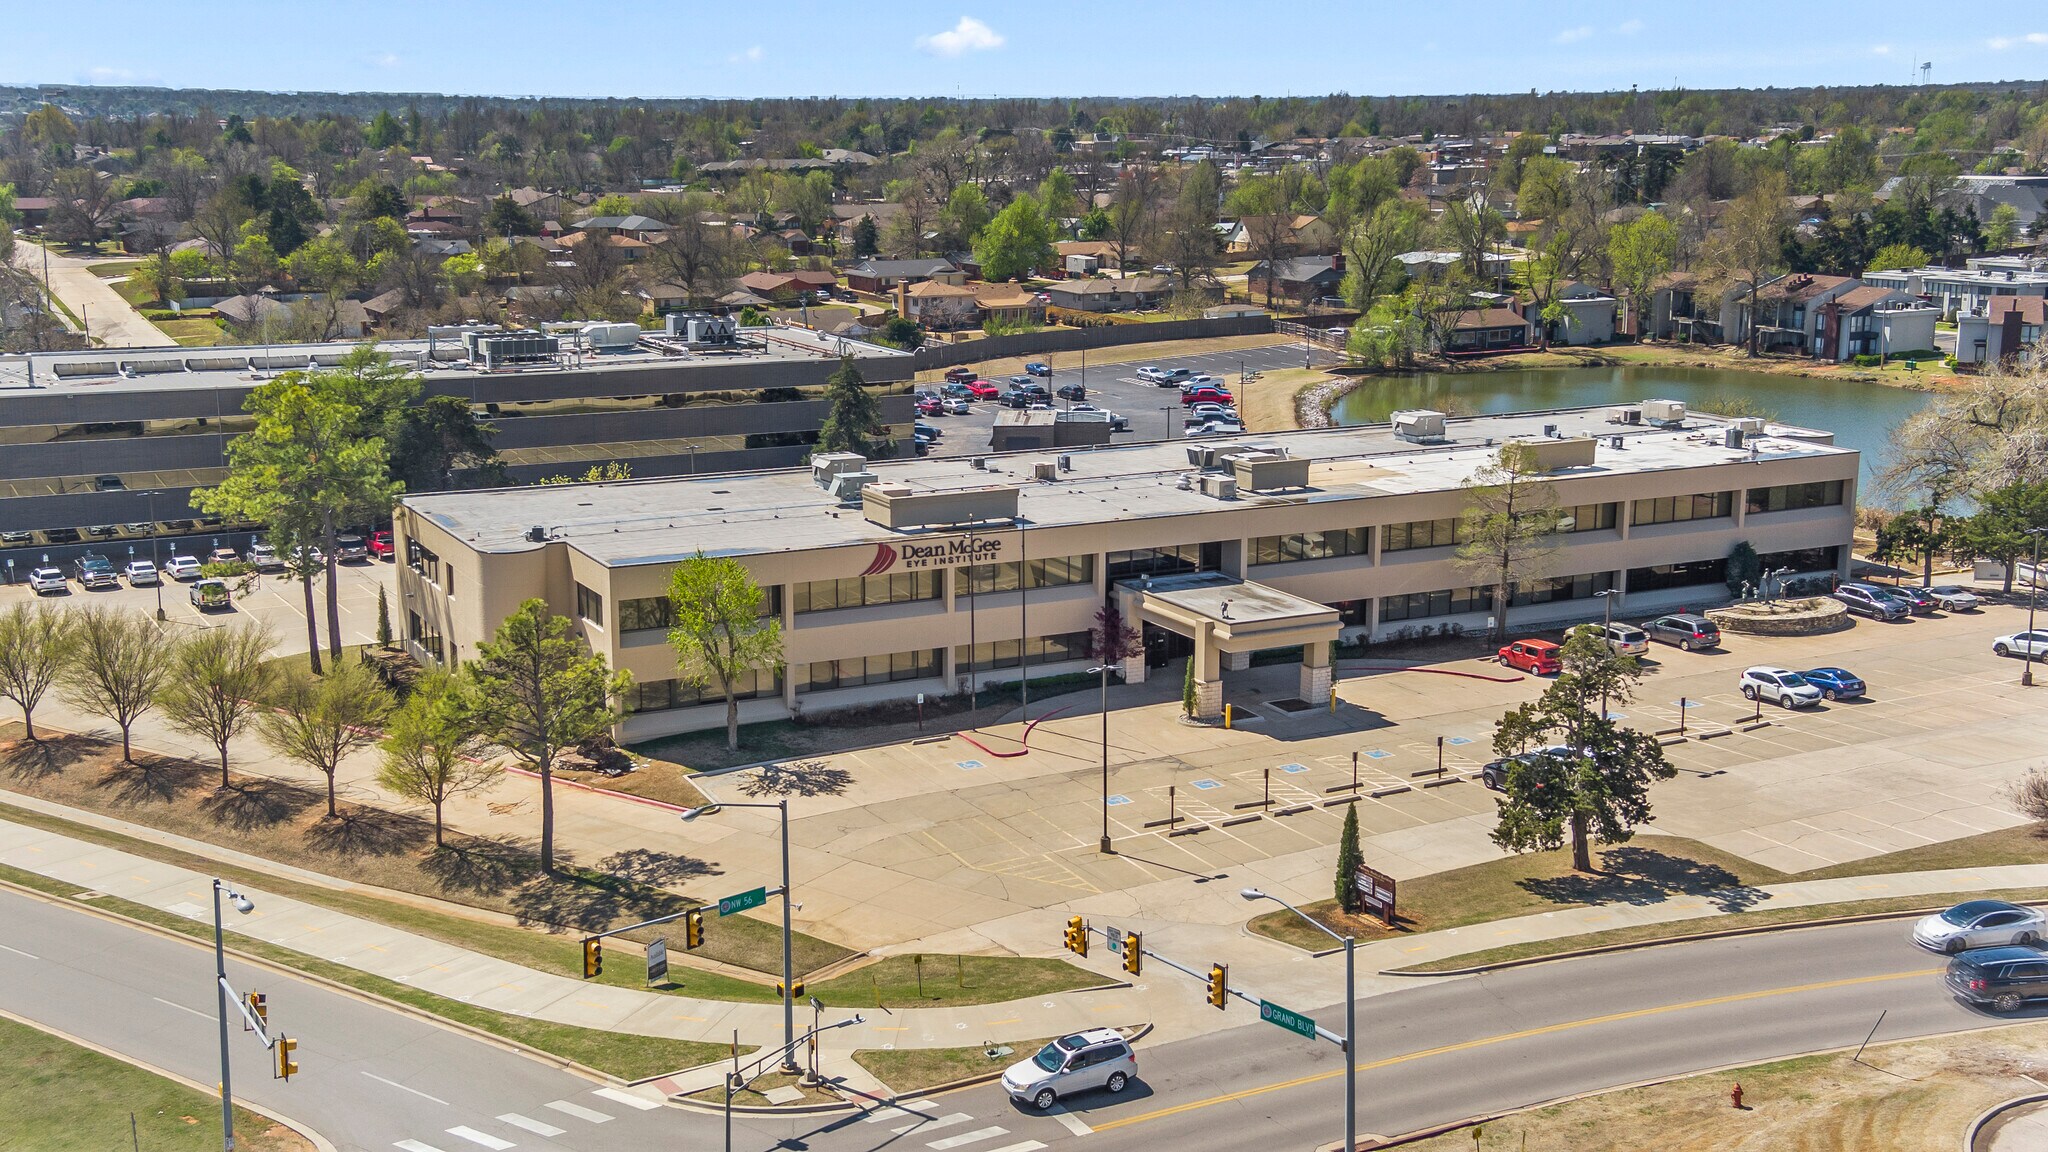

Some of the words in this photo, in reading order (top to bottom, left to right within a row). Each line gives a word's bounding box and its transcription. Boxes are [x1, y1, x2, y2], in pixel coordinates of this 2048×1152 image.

[901, 545, 946, 560] Dean
[948, 538, 1002, 556] McGee
[906, 559, 928, 568] EYE
[934, 552, 997, 566] INSTITUTE
[731, 899, 741, 909] NW
[743, 895, 753, 906] 56
[1272, 1009, 1296, 1027] GRAND
[1297, 1019, 1315, 1035] BLVD
